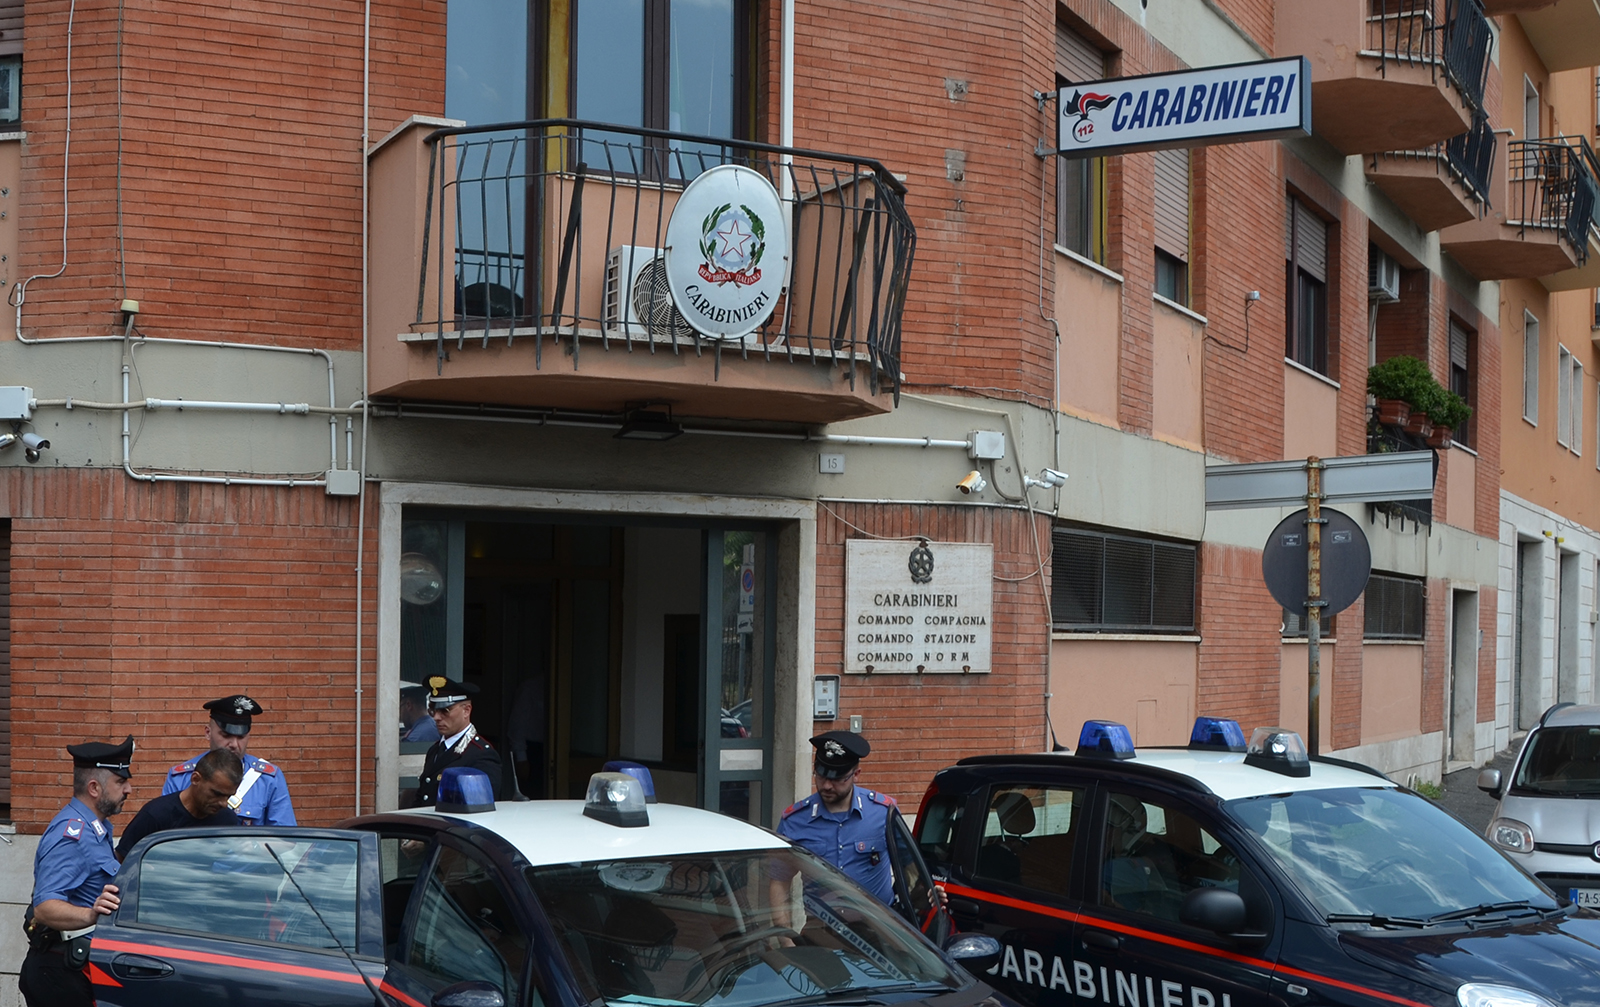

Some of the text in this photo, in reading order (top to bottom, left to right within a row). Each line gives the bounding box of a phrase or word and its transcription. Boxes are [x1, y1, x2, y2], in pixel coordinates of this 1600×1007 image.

[1111, 73, 1297, 132] CARABINIERI
[1077, 123, 1095, 137] 112
[735, 272, 761, 285] ITALIANA
[684, 284, 770, 324] CARABINIERI
[827, 458, 838, 469] 15
[874, 593, 958, 608] CARABINIERI
[857, 615, 987, 626] COMANDO COMPAGNIA
[857, 633, 977, 644] COMANDO STAZIONE
[857, 652, 914, 662] COMANDO
[986, 945, 1232, 1007] ARABINIER
